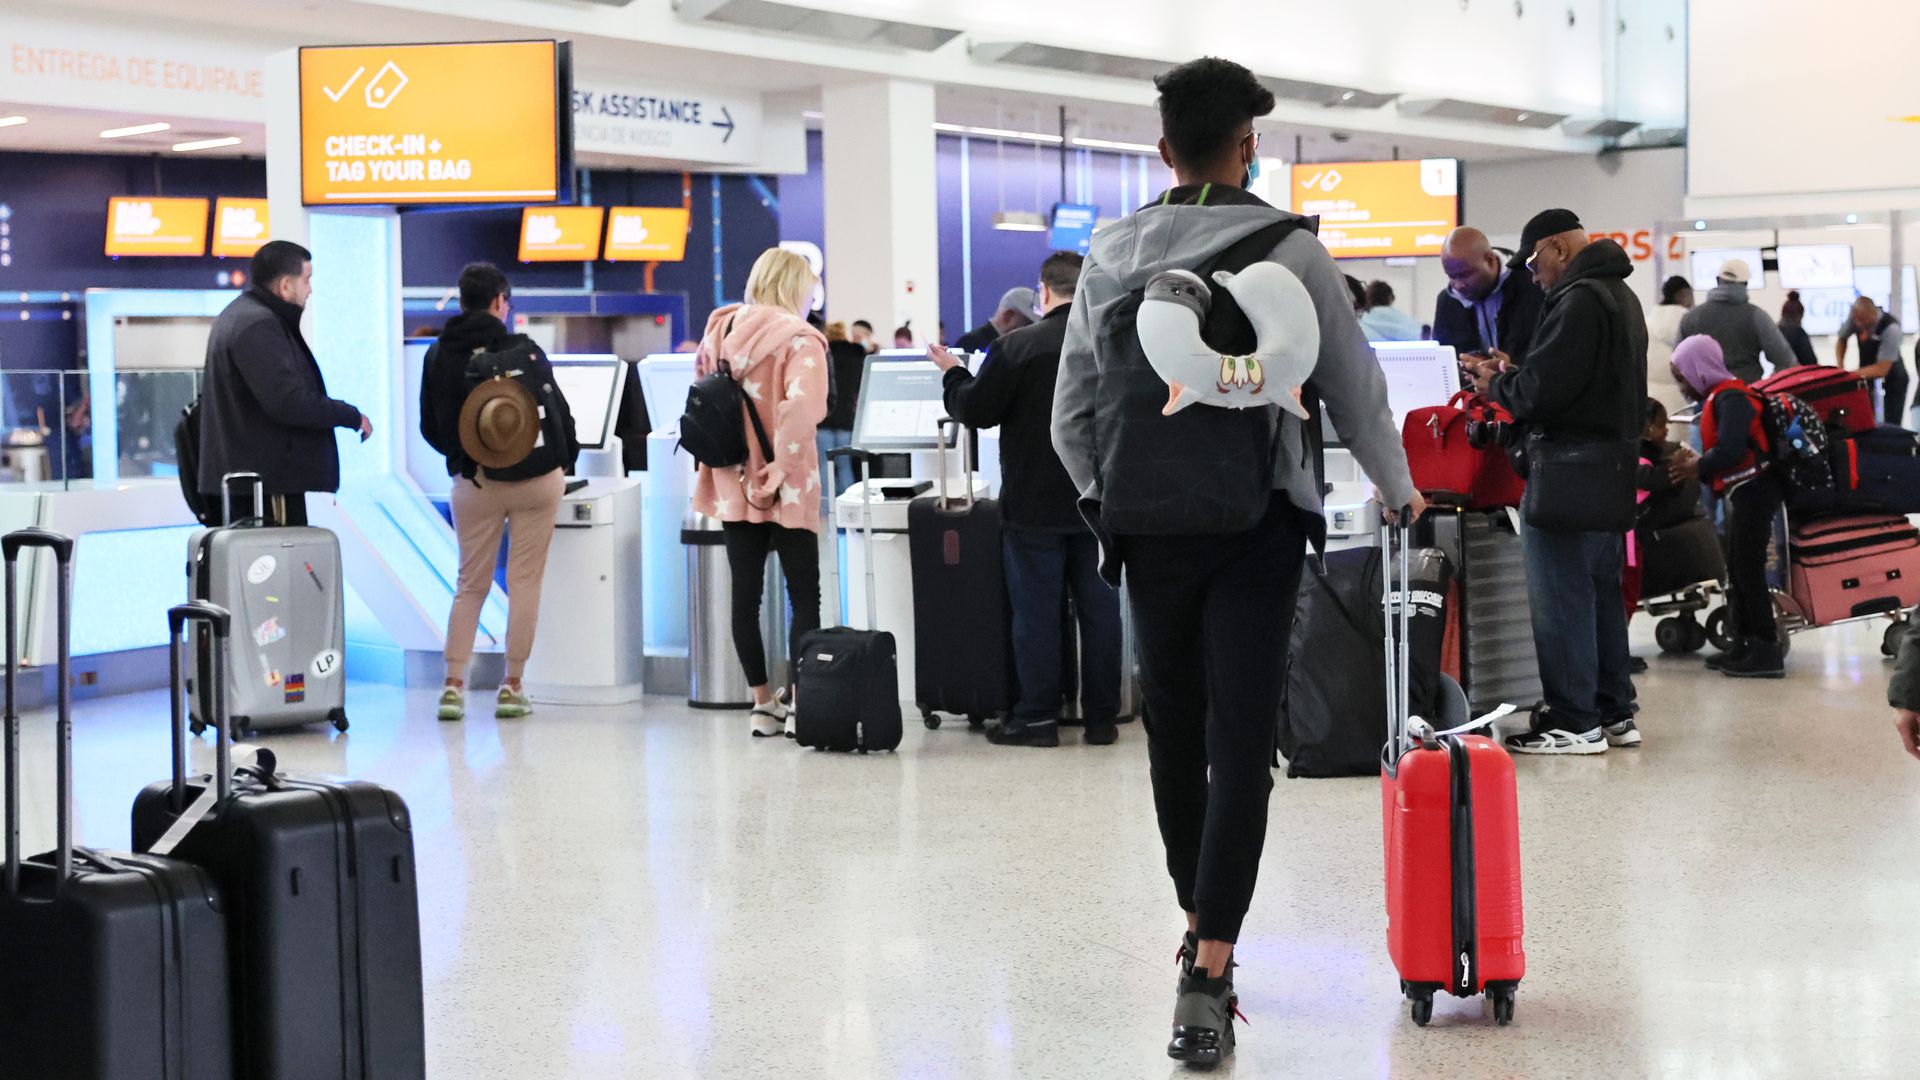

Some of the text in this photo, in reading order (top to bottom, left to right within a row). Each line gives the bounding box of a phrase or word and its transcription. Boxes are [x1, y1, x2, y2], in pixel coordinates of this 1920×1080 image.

[12, 44, 264, 98] ENTREGA DE EQUIPAJE
[600, 95, 702, 124] ASSISTANCE
[325, 134, 442, 157] CHECK-IN +
[325, 159, 471, 182] TAG YOUR BAG
[1436, 169, 1443, 186] 1
[316, 653, 335, 674] LP
